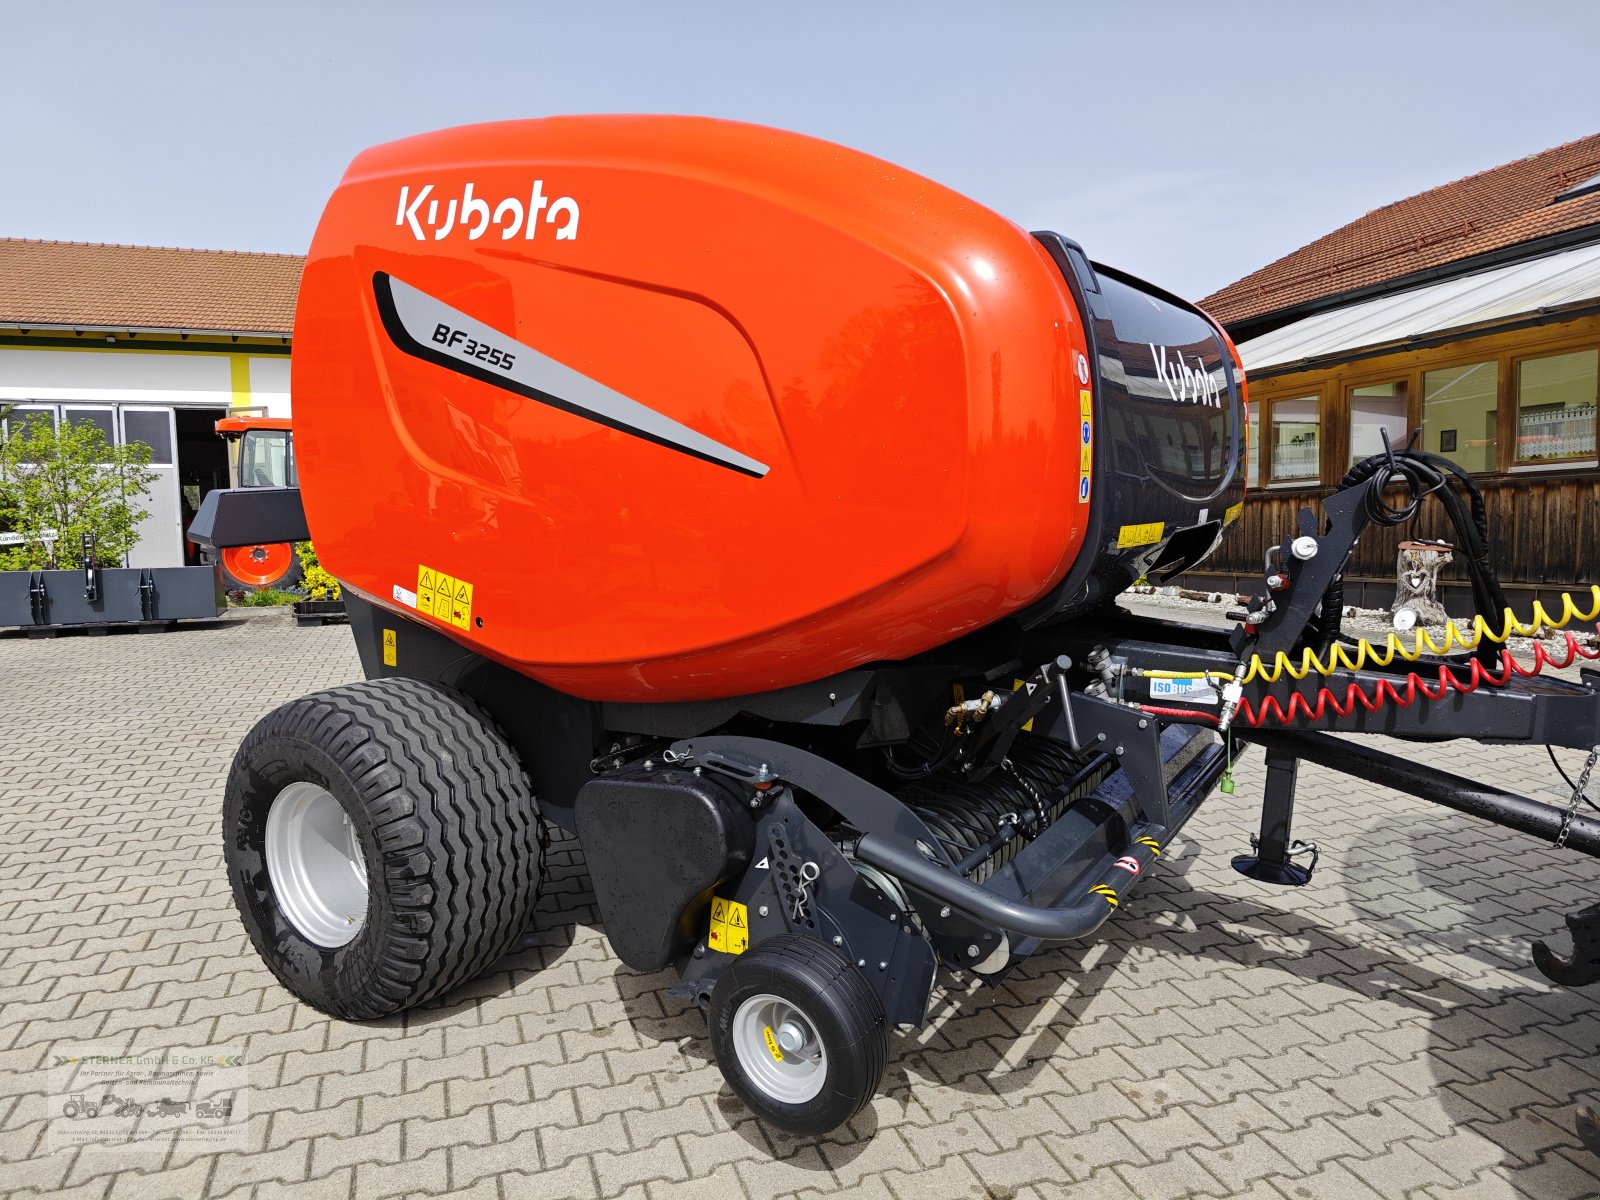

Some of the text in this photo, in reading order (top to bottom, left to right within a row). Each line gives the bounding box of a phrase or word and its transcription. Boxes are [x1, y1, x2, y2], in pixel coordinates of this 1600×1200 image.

[395, 179, 580, 241] Kubota
[431, 323, 516, 371] BF3255
[1149, 342, 1221, 408] Kubota
